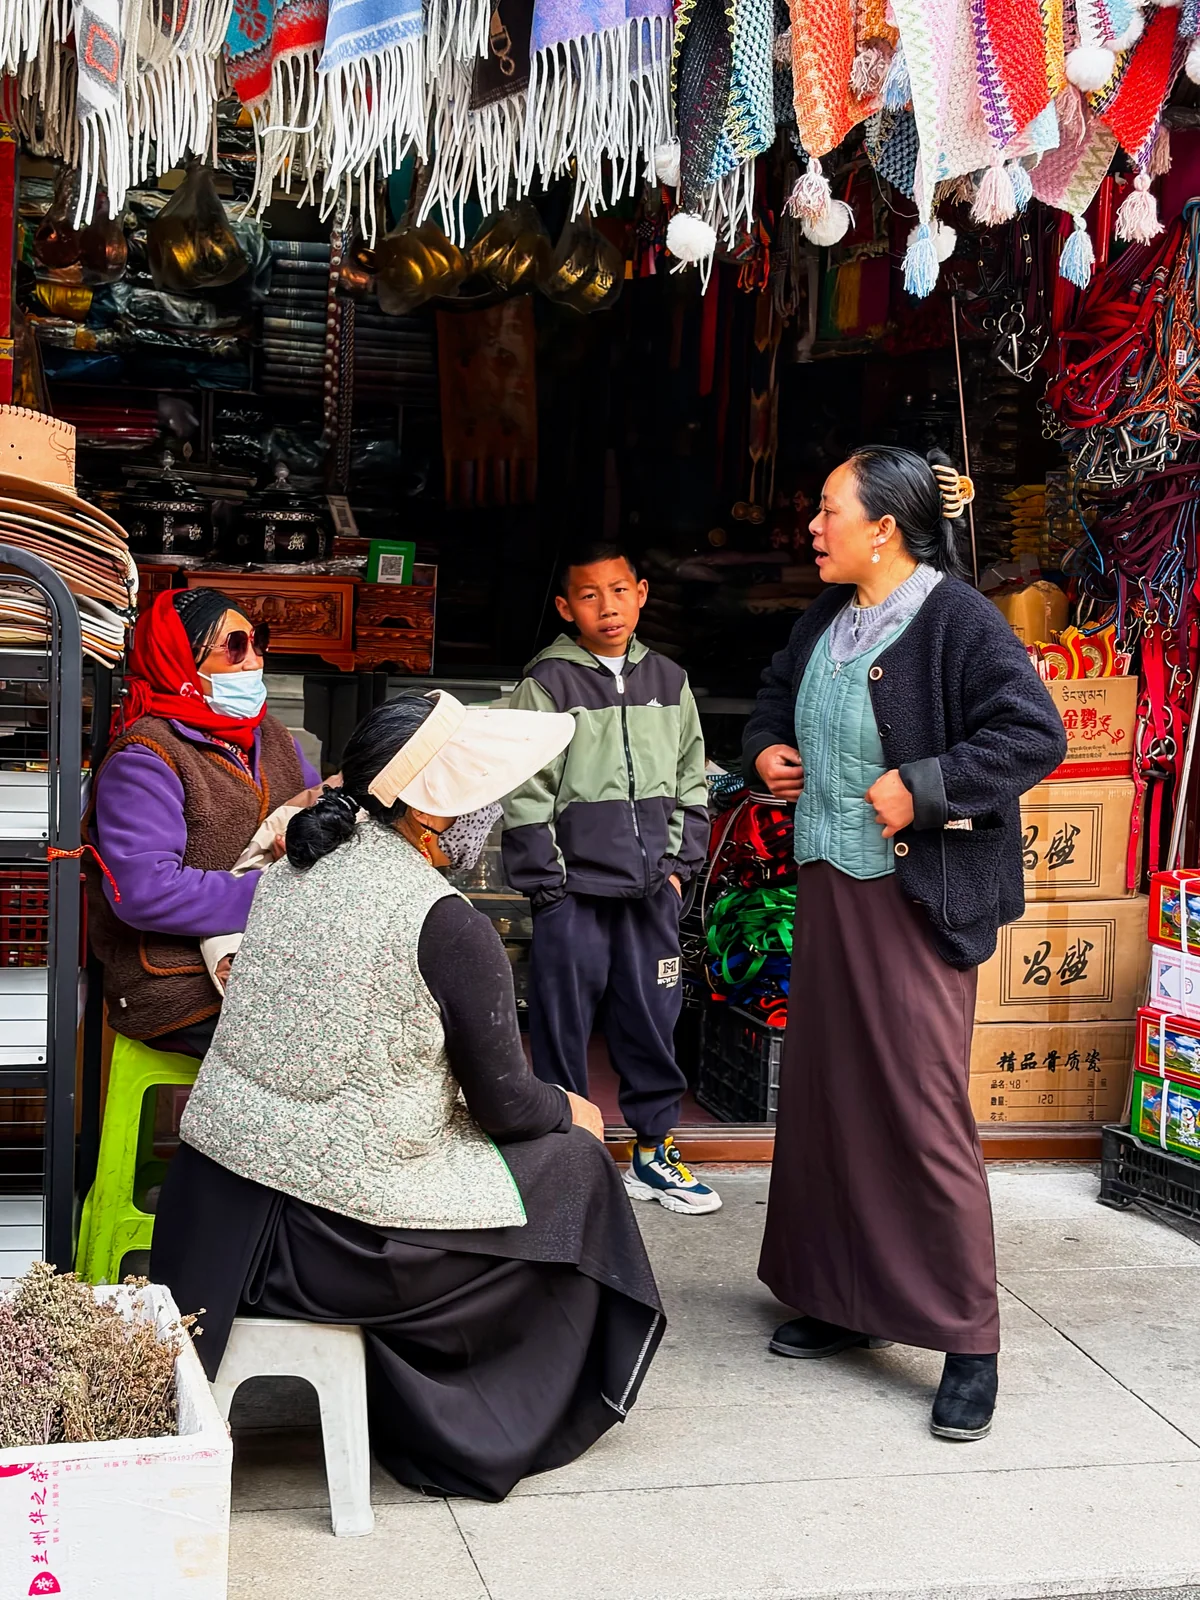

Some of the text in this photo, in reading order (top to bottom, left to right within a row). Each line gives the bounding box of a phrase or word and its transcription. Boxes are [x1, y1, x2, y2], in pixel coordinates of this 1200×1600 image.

[996, 1049, 1101, 1073] 精品骨质瓷
[1037, 1094, 1054, 1105] 120
[28, 1468, 50, 1565] 兰州华之荣
[34, 1577, 54, 1591] 荣
